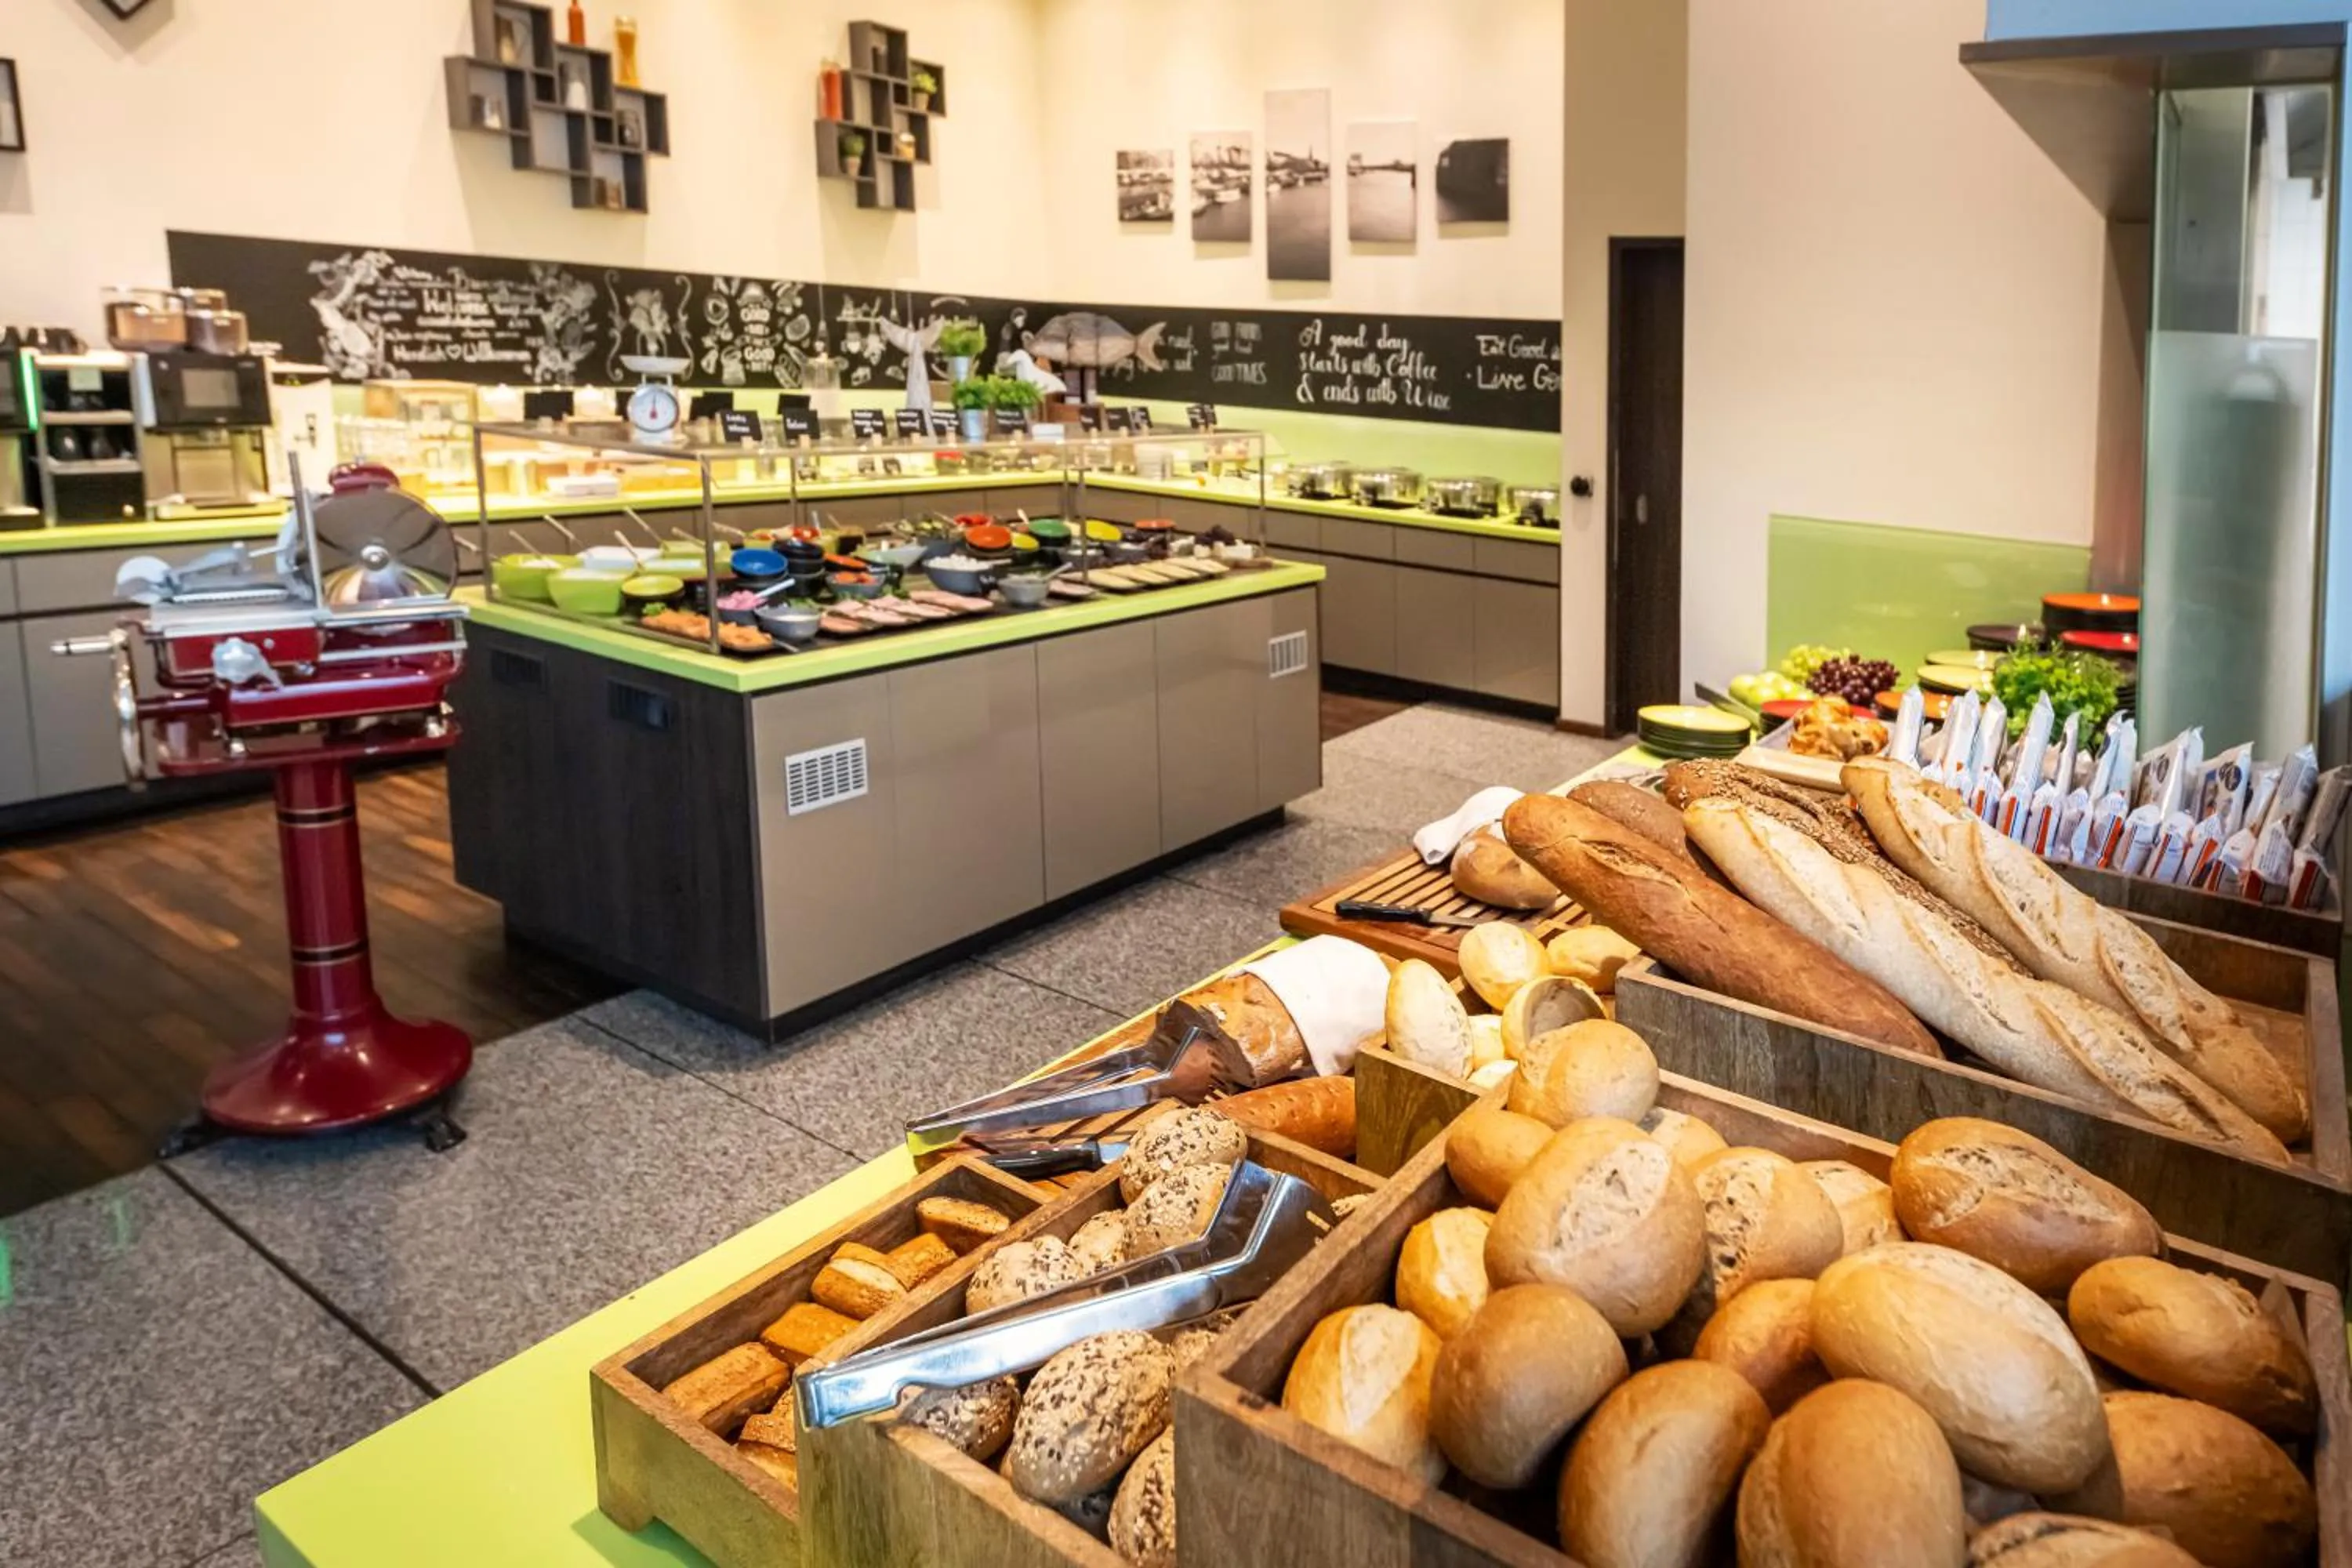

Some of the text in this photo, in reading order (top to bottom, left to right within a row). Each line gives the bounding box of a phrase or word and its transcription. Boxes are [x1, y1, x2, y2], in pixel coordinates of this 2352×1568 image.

[1329, 324, 1368, 356] good
[1377, 322, 1408, 362] day
[1508, 333, 1548, 359] Good
[1323, 374, 1360, 404] ends
